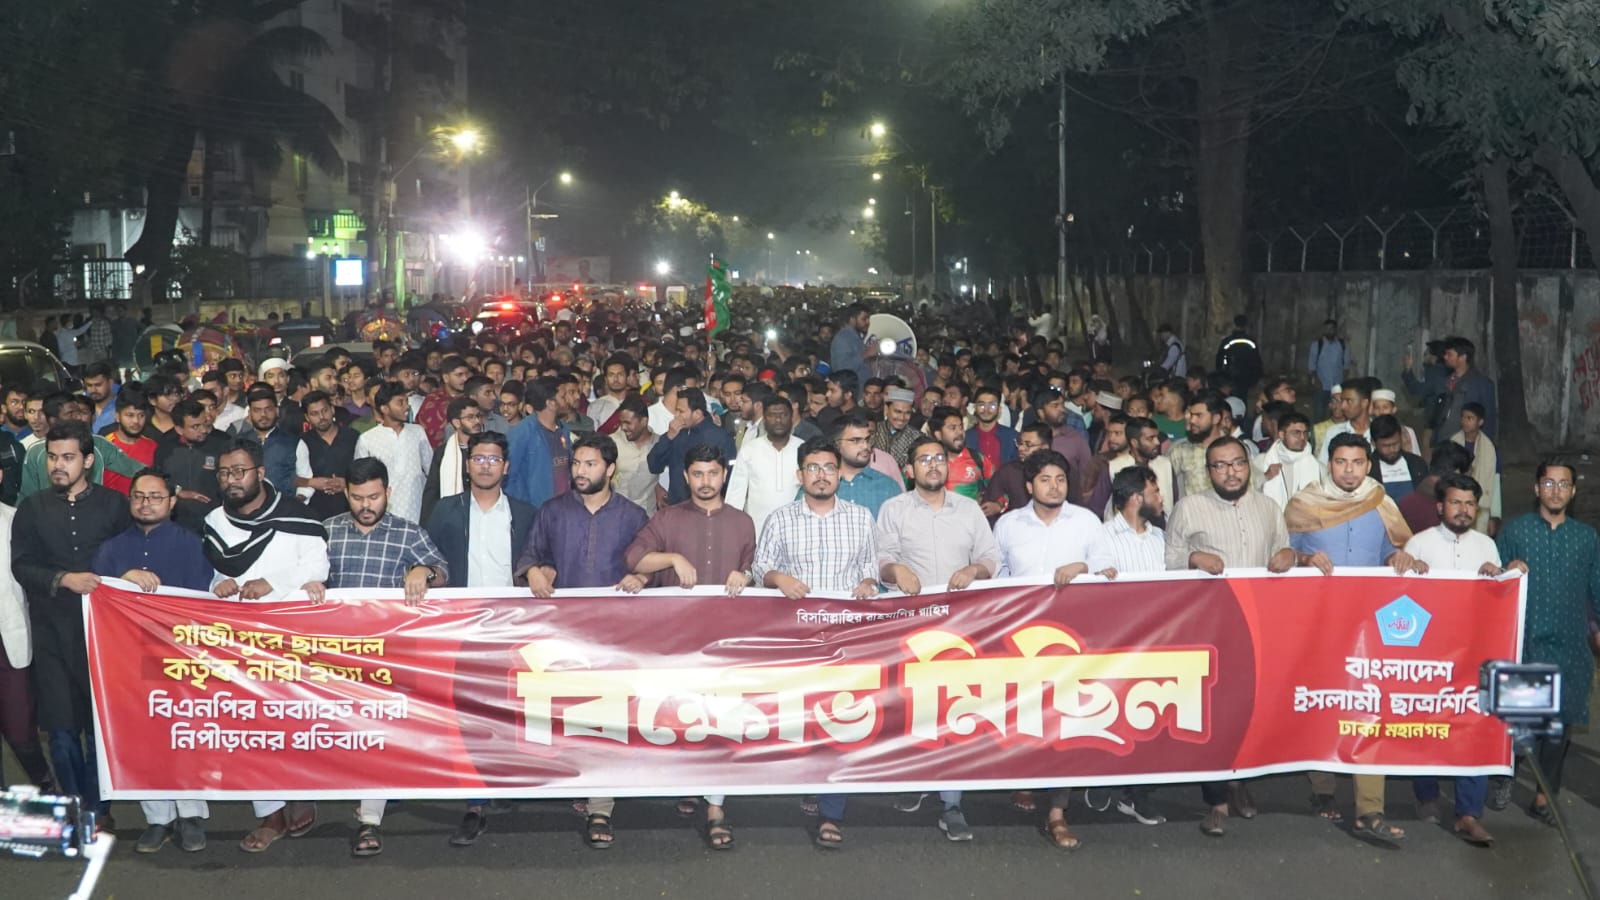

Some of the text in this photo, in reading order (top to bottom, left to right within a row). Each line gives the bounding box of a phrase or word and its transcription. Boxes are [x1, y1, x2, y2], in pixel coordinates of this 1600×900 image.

[796, 608, 862, 625] বিসমিল্লাহির
[163, 650, 239, 690] কর্তৃক
[246, 653, 302, 683] নারী
[370, 667, 393, 685] ও
[1345, 656, 1455, 683] বাংলাদেশ
[517, 625, 1210, 745] বিক্ষোভ মিছিল
[1294, 682, 1490, 717] ইসলামী ছাত্রশিবি
[148, 689, 409, 720] বিএনপির অব্যাহত নারী
[170, 722, 385, 752] নিপীড়নের প্রতিবাদে
[1338, 719, 1451, 740] ঢাকা মহানগর
